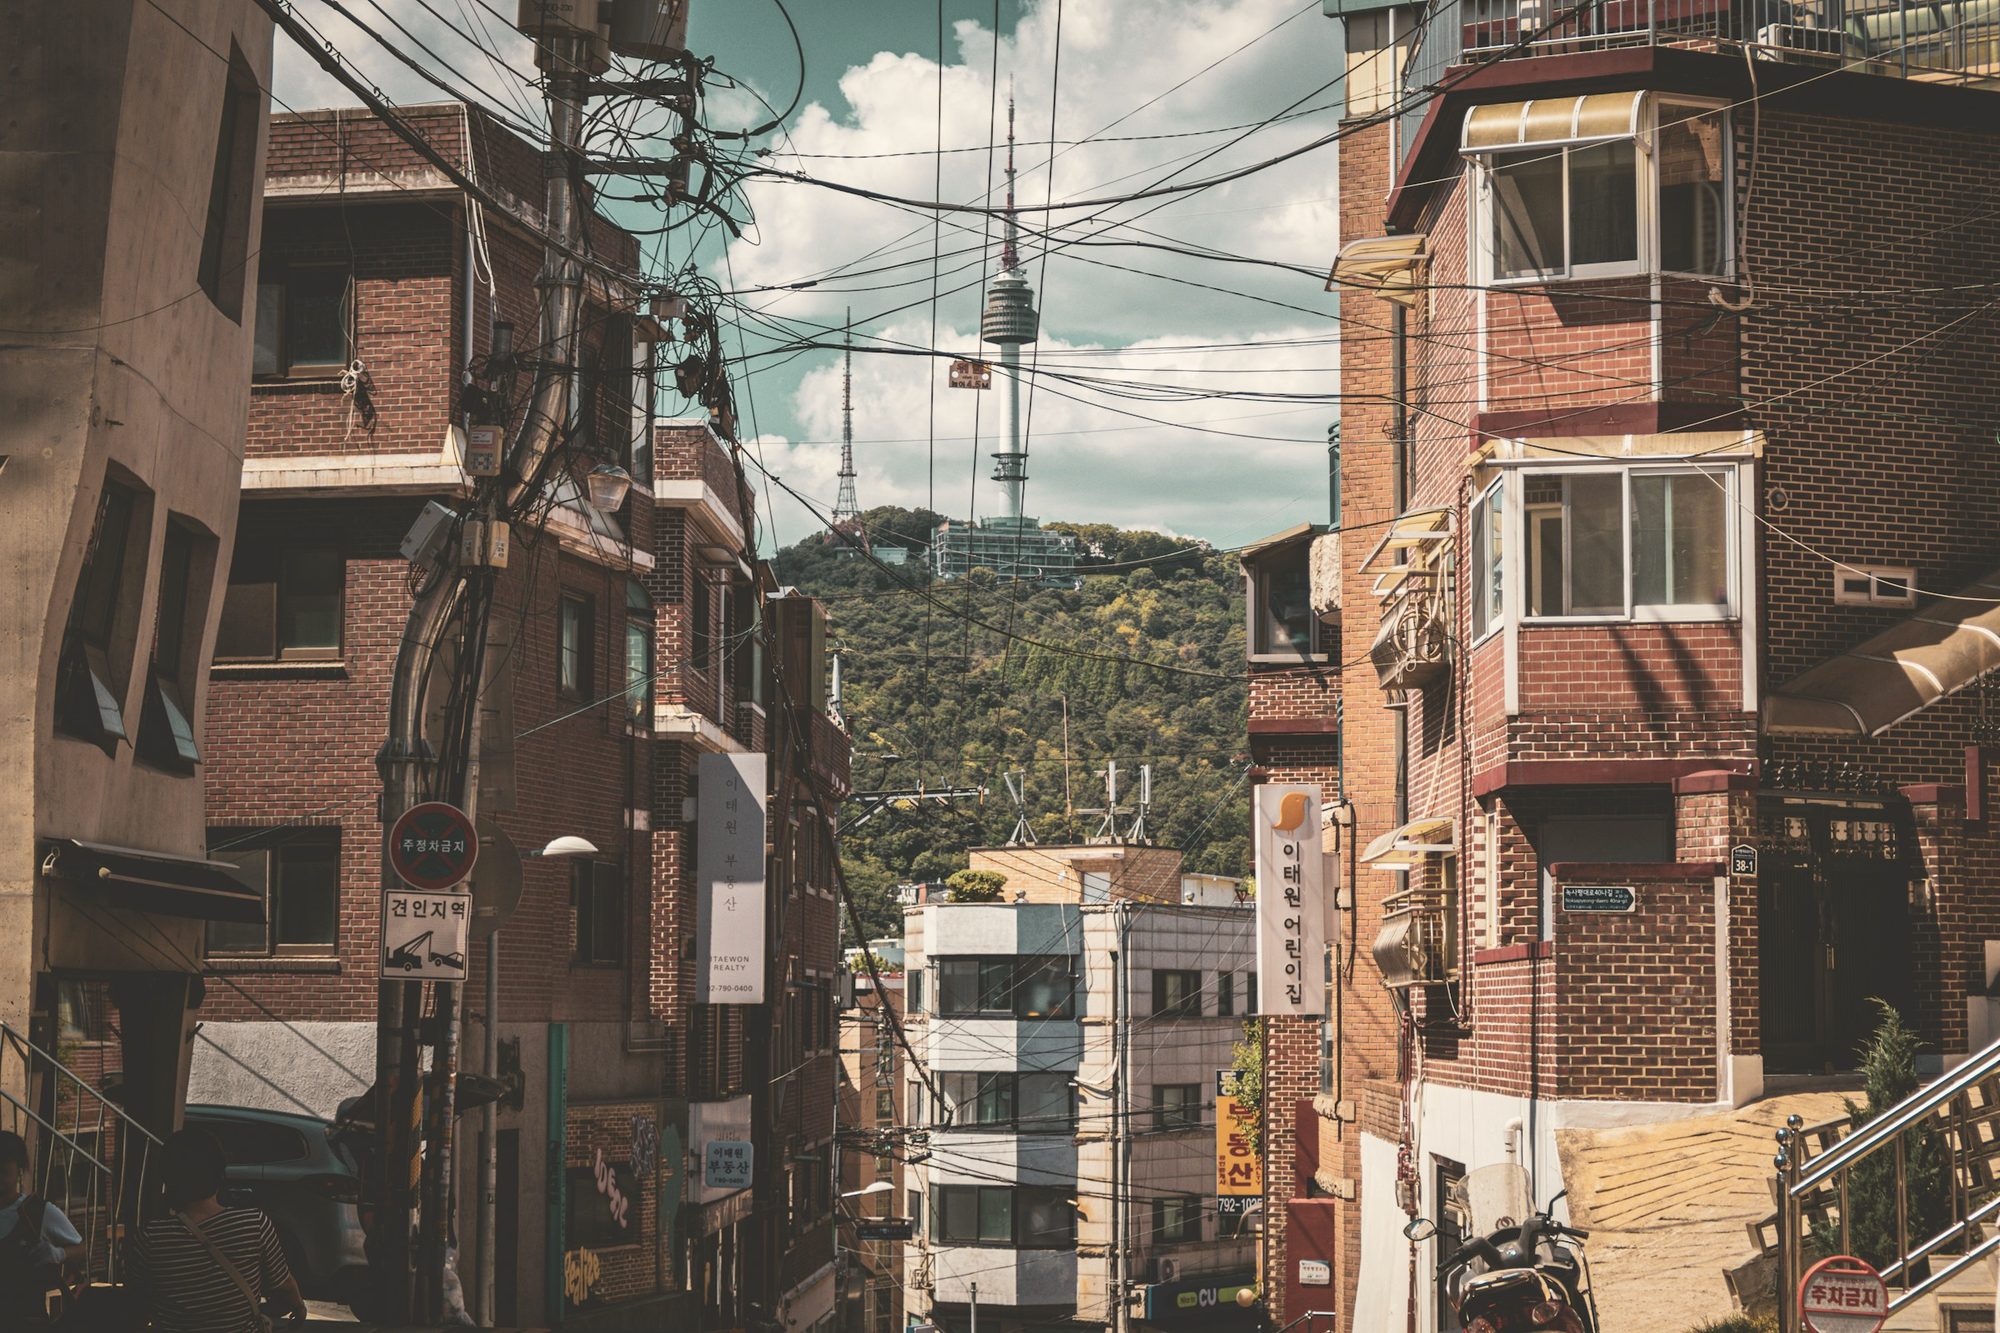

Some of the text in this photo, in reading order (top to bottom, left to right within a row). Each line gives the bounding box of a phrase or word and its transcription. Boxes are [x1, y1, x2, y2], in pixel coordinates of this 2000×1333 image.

[403, 839, 464, 853] 주정차금지
[723, 776, 738, 912] 이태원 부동산
[1735, 859, 1753, 872] 38-1
[391, 898, 466, 920] 견인지역
[1283, 841, 1302, 1005] 이태원 어린이집
[713, 1147, 743, 1159] 이태원
[708, 1160, 750, 1175] 부동산
[1199, 1288, 1217, 1307] CU
[1811, 1285, 1877, 1308] 주차금지
